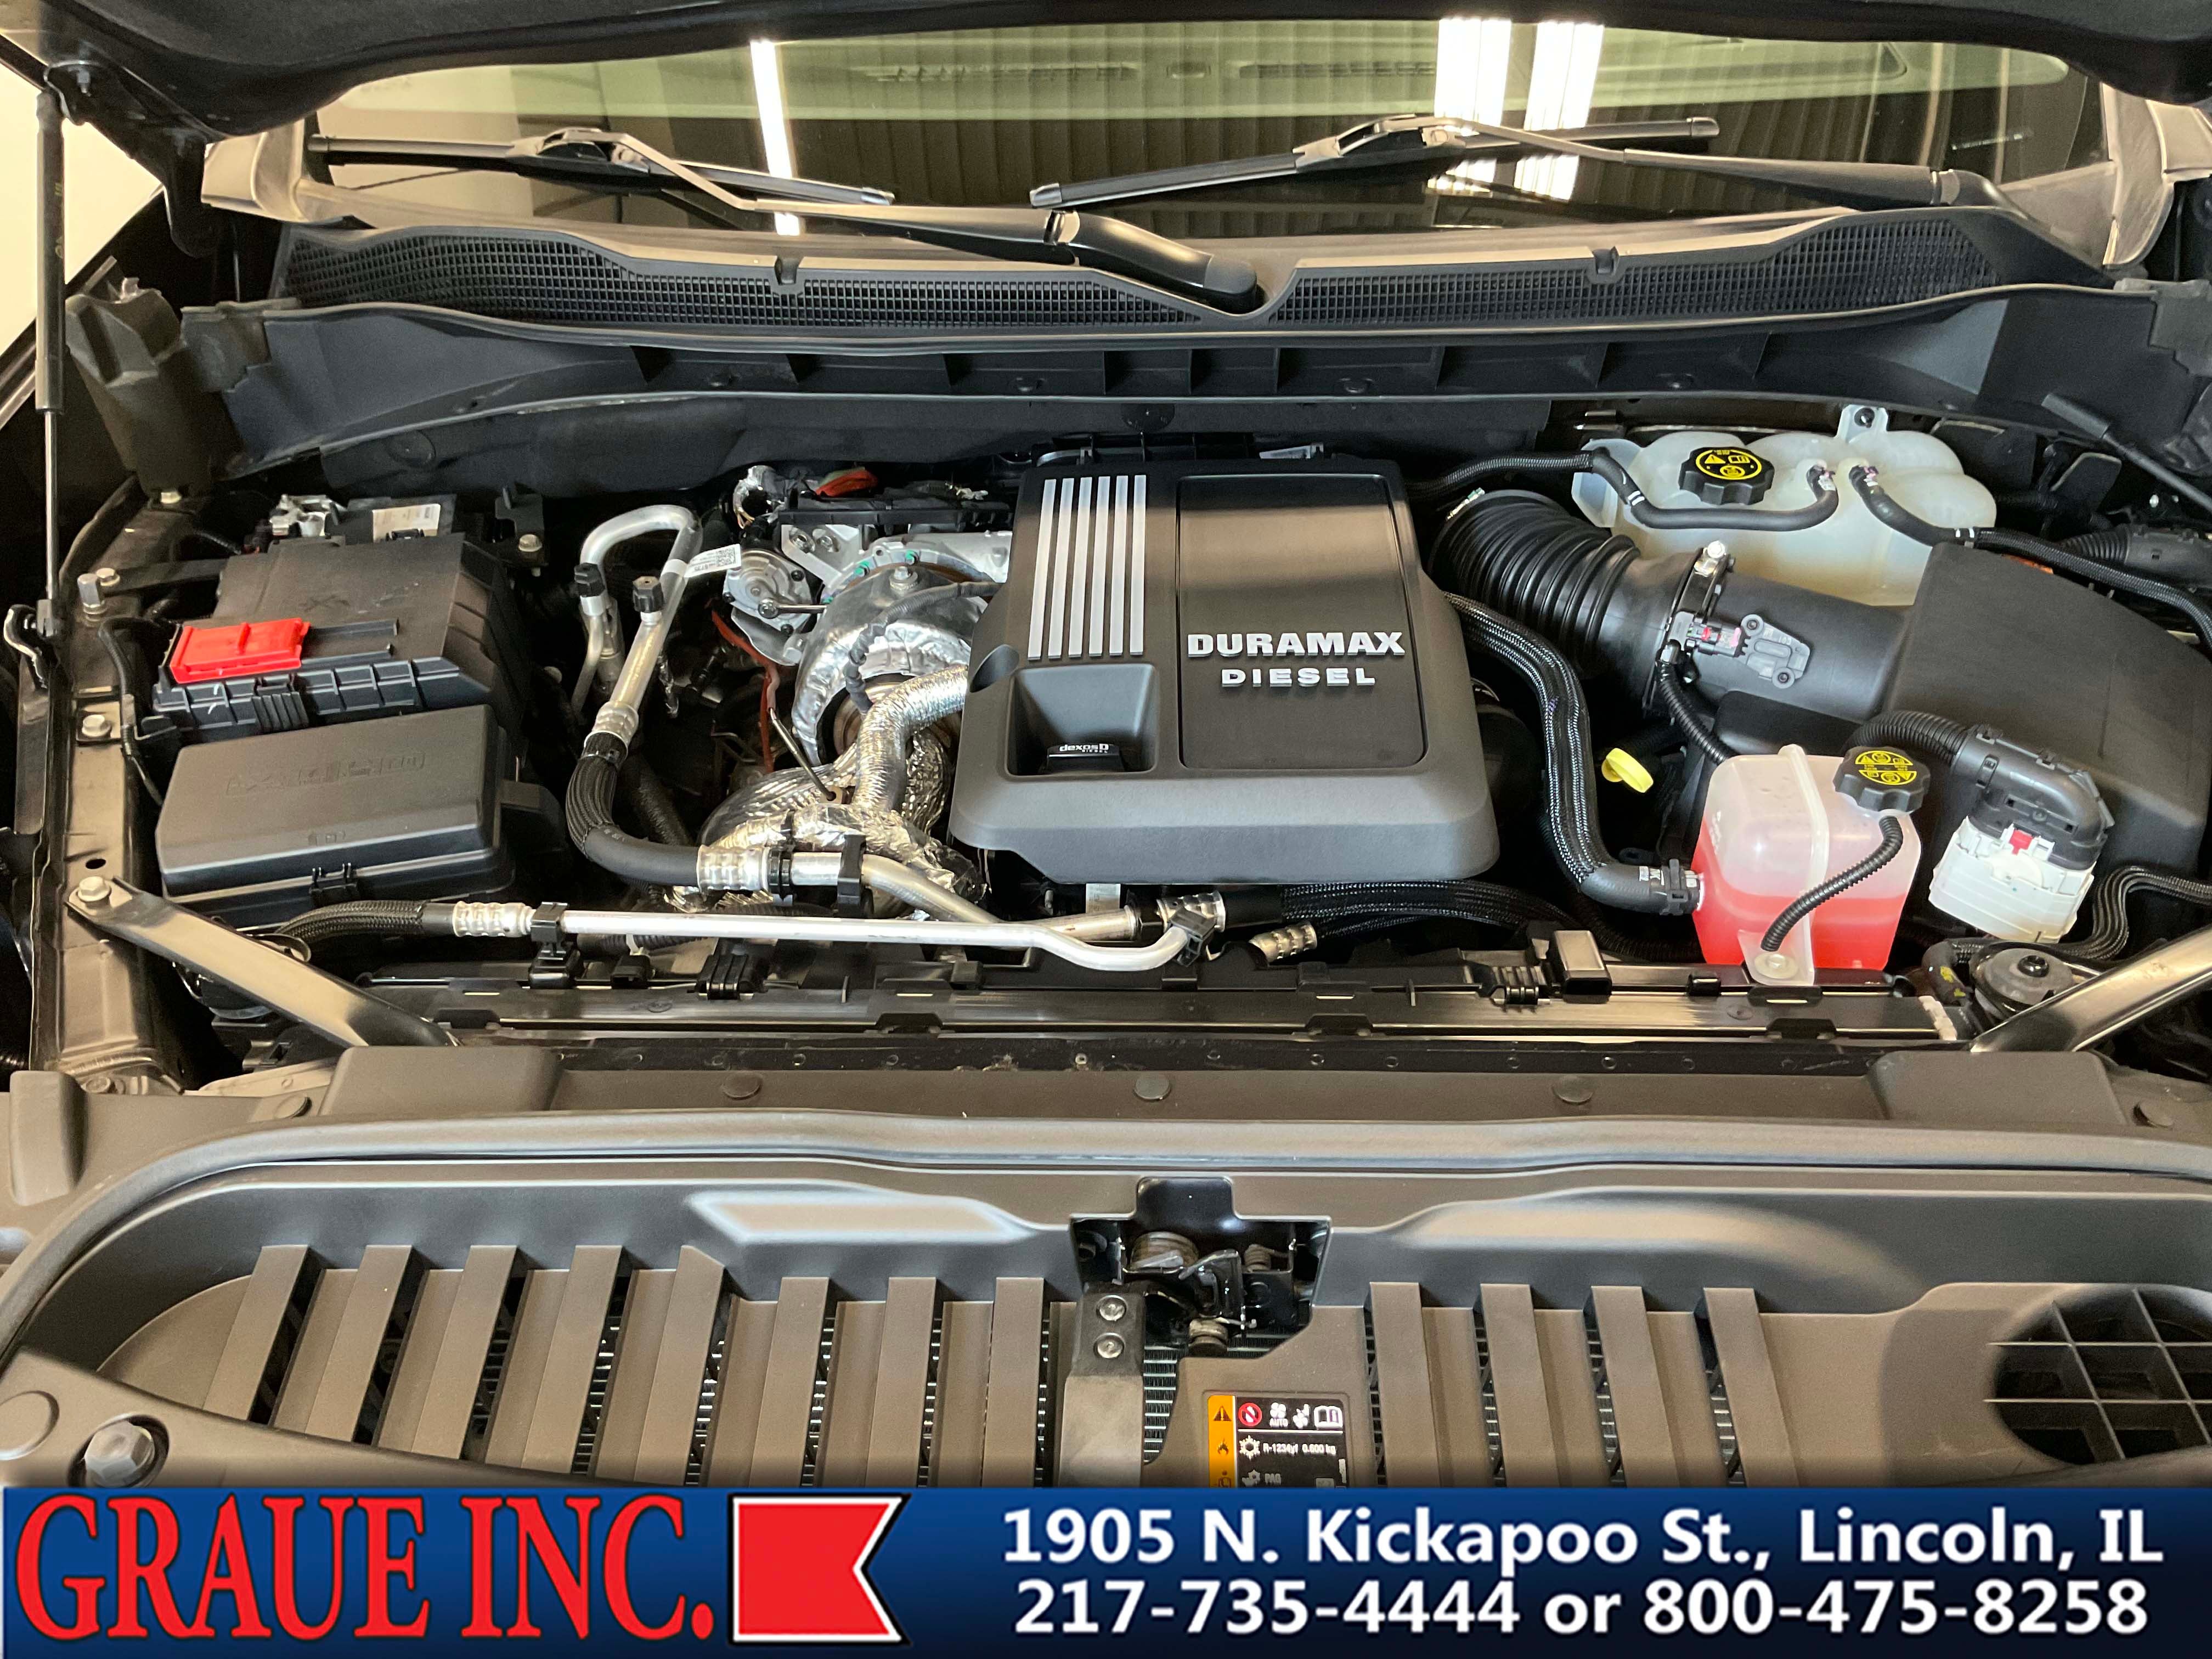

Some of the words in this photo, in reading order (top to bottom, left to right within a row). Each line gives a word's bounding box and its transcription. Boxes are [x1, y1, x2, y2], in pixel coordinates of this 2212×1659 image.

[1188, 632, 1405, 657] DURAMAX
[1222, 668, 1375, 687] DIESEL
[1269, 1418, 1288, 1427] AUTO
[1325, 1443, 1336, 1456] kg
[1265, 1473, 1282, 1485] PAG
